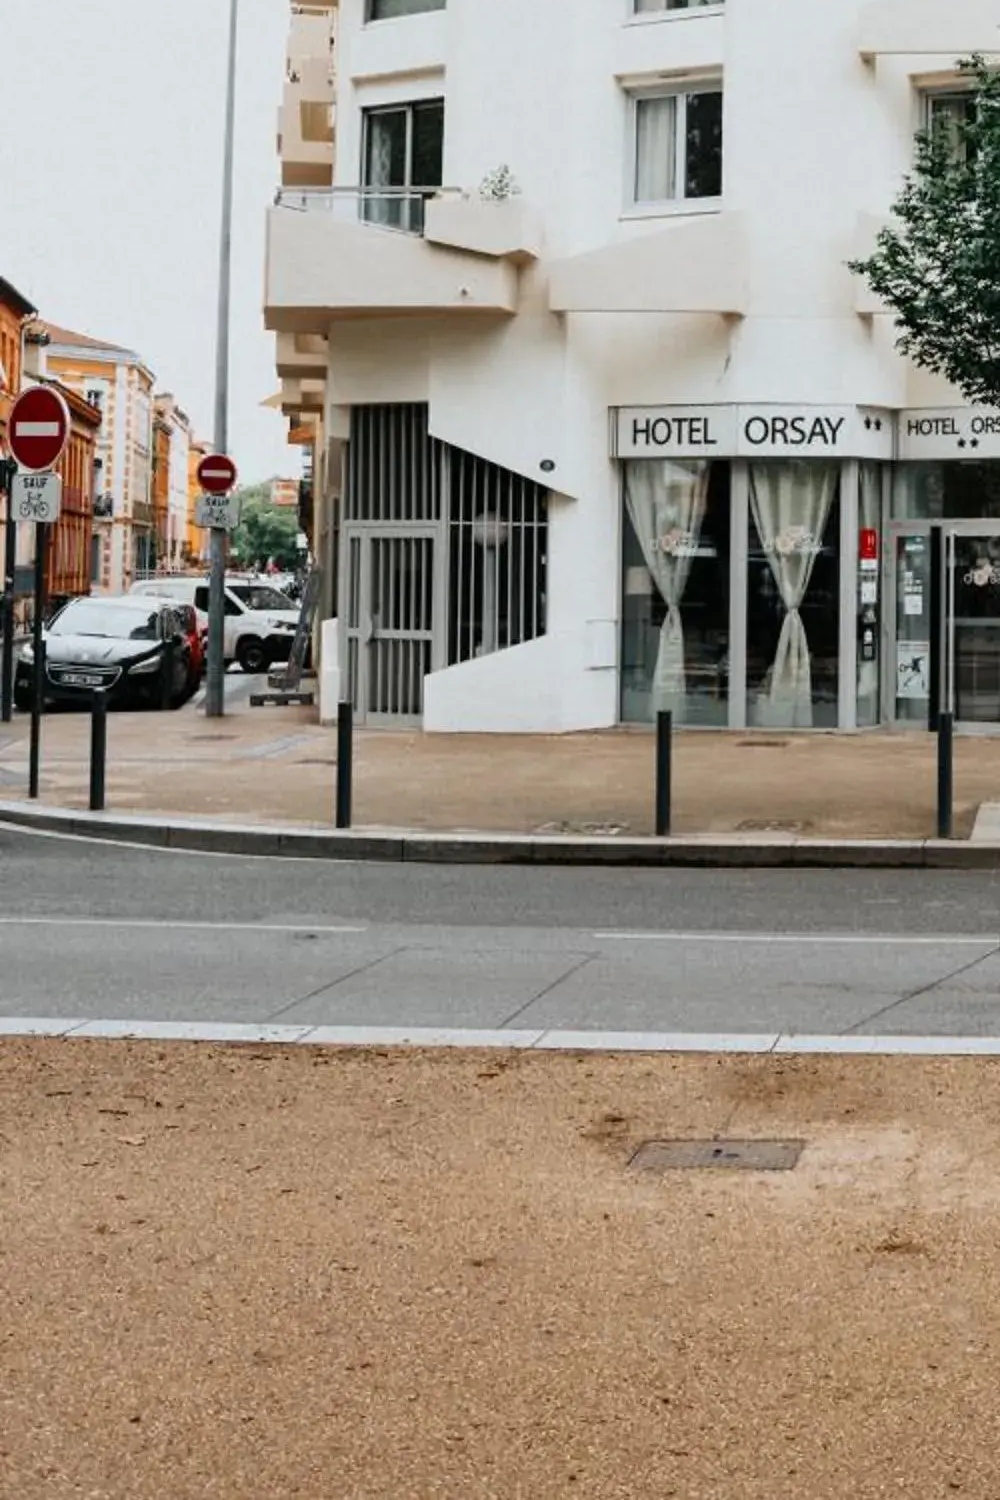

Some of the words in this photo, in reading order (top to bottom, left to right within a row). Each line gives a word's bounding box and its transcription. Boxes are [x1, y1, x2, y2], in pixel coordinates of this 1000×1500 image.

[632, 417, 717, 445] HOTEL
[744, 416, 845, 445] ORSAY
[907, 417, 960, 436] HOTEL
[23, 477, 48, 489] SAUF
[205, 496, 230, 507] SAUF
